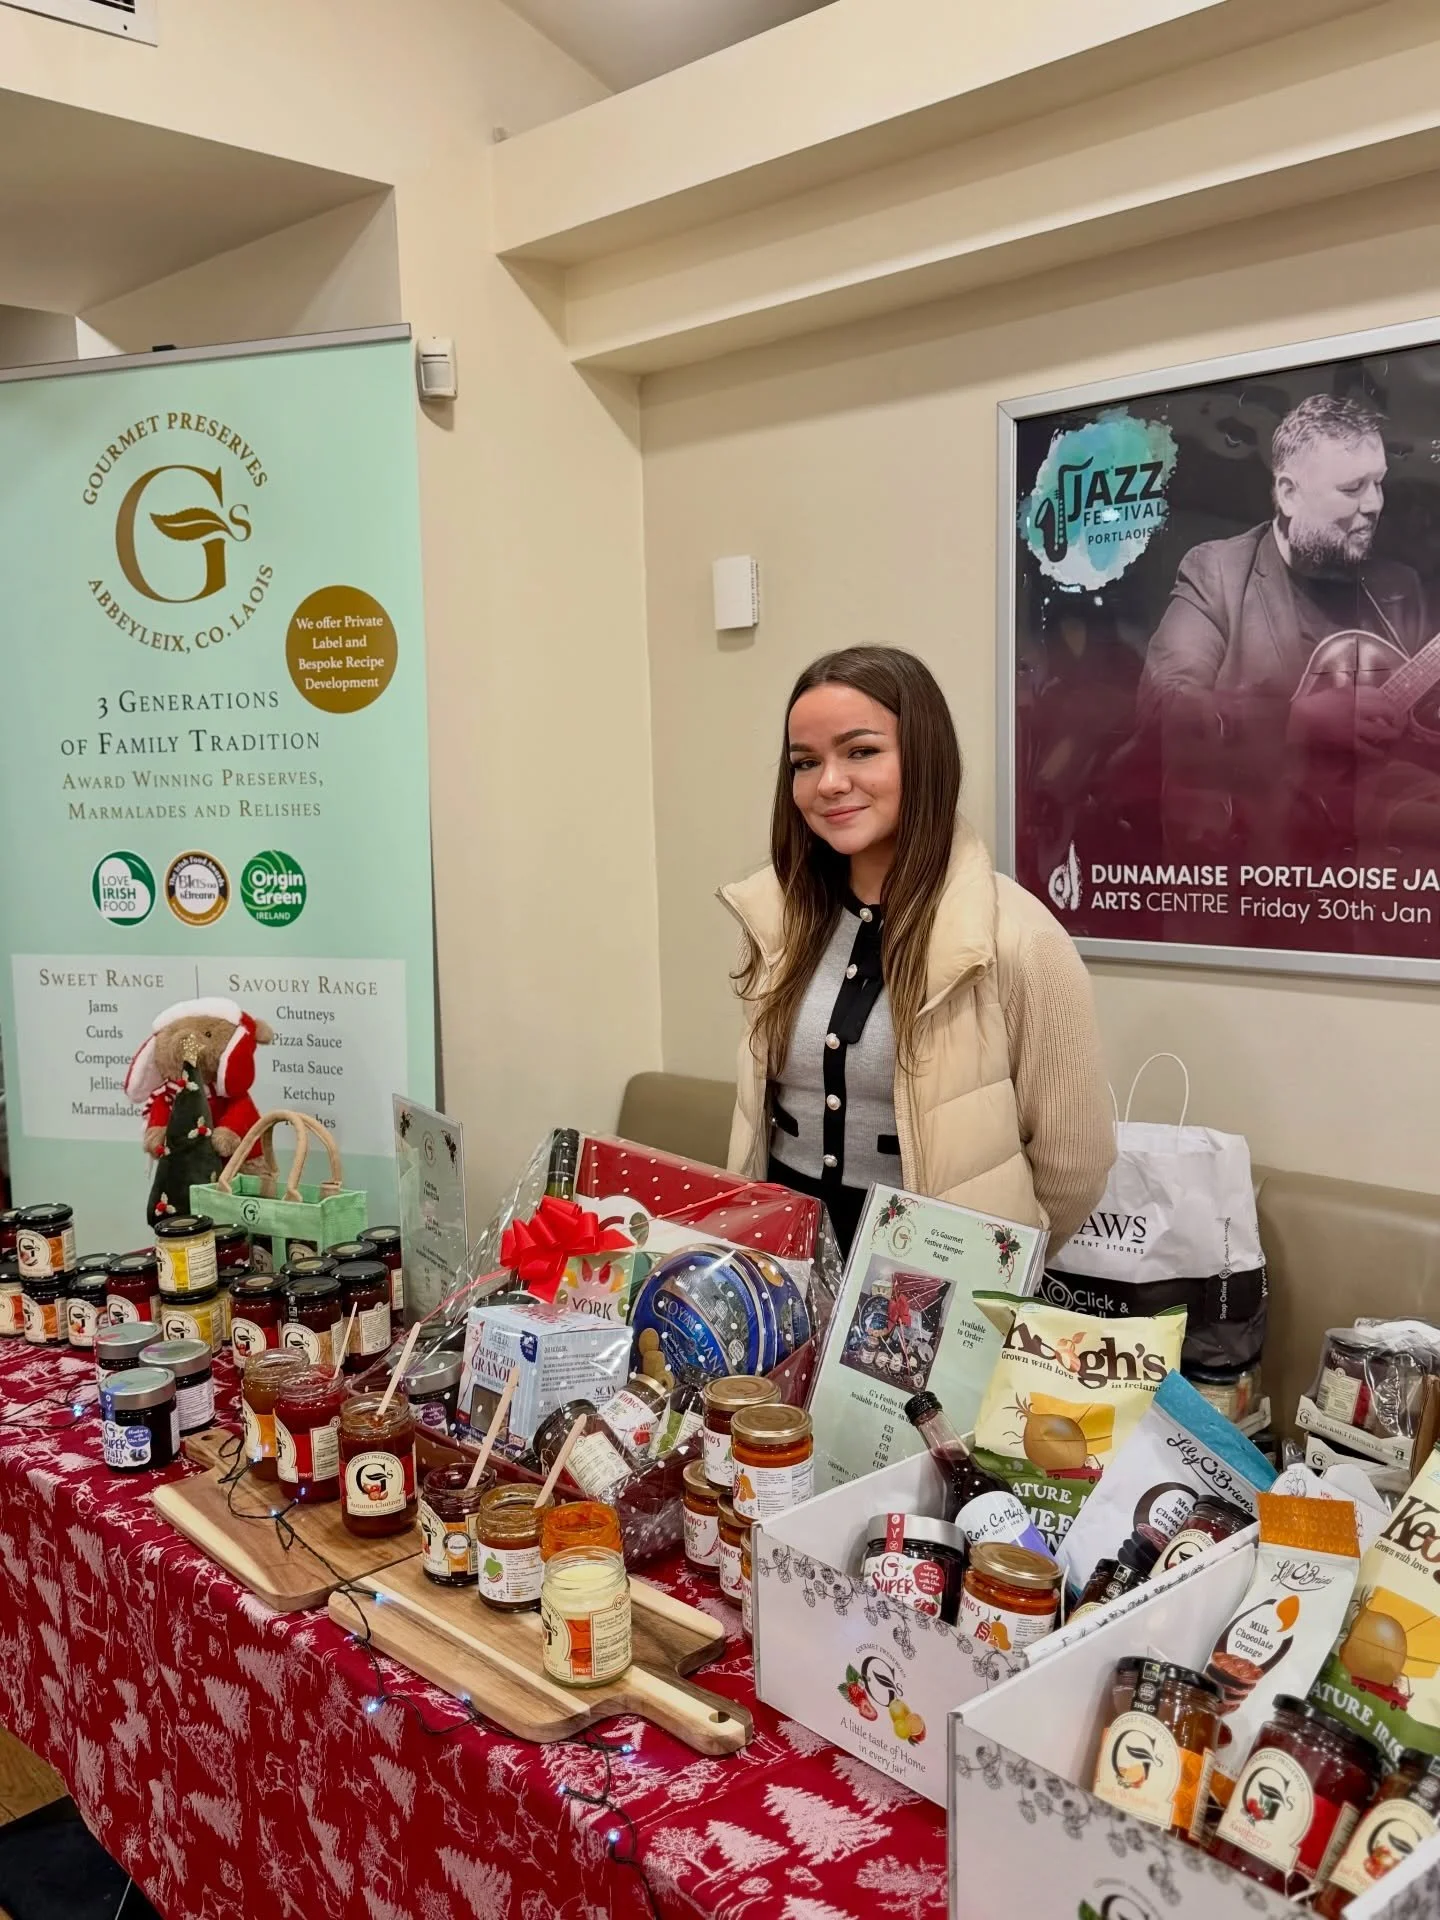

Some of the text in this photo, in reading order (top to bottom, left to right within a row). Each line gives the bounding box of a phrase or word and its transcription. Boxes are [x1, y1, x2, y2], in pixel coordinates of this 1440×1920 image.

[83, 412, 267, 505] GOURMET PRESERVES
[1068, 461, 1163, 523] JAZZ
[1084, 503, 1163, 527] FESTIVAL
[88, 565, 273, 654] ABBEYLEIX, CO. LAOIS
[297, 615, 383, 629] We offer Private
[312, 635, 367, 649] Label and
[299, 656, 384, 672] Bespoke Recipe
[305, 676, 379, 692] Development
[98, 698, 108, 719] 3
[102, 876, 130, 887] LOVE
[252, 870, 303, 889] Origin
[1091, 864, 1228, 887] DUNAMAISE
[1240, 866, 1440, 892] PORTLAOISE JA
[103, 888, 136, 899] IRISH
[253, 890, 302, 905] Green
[104, 901, 135, 911] FOOD
[1091, 892, 1228, 914] ARTS CENTRE
[1240, 897, 1431, 923] Friday 30th Jan
[256, 912, 290, 920] IRELAND
[89, 1000, 118, 1014] Jams
[276, 1007, 335, 1022] Chutneys
[86, 1026, 123, 1039] Curds
[272, 1034, 342, 1049] Pizza Sauce
[272, 1060, 343, 1075] Pasta Sauce
[283, 1087, 335, 1105] Ketchup
[71, 1102, 143, 1117] Marmalade
[1078, 1212, 1147, 1240] AWS
[924, 1238, 964, 1255] Festive Hamper
[940, 1232, 963, 1244] Gourmet
[933, 1252, 949, 1262] Range
[1107, 1244, 1144, 1254] STORES
[1074, 1290, 1115, 1311] Click
[1120, 1302, 1129, 1313] &
[1220, 1303, 1228, 1320] Shop
[960, 1320, 986, 1334] Available
[1001, 1350, 1028, 1364] Grown
[1031, 1358, 1053, 1371] with
[1055, 1366, 1074, 1380] love
[1012, 1482, 1072, 1504] ATURE
[967, 1524, 988, 1544] Rose
[1374, 1540, 1429, 1574] Grown with love
[1249, 1620, 1270, 1636] Milk
[1235, 1628, 1274, 1651] Chocolate
[1234, 1640, 1263, 1659] Orange
[1310, 1681, 1405, 1760] ATURE IRIS
[840, 1717, 926, 1773] A little taste of Home
[858, 1744, 867, 1755] in
[869, 1749, 890, 1771] every
